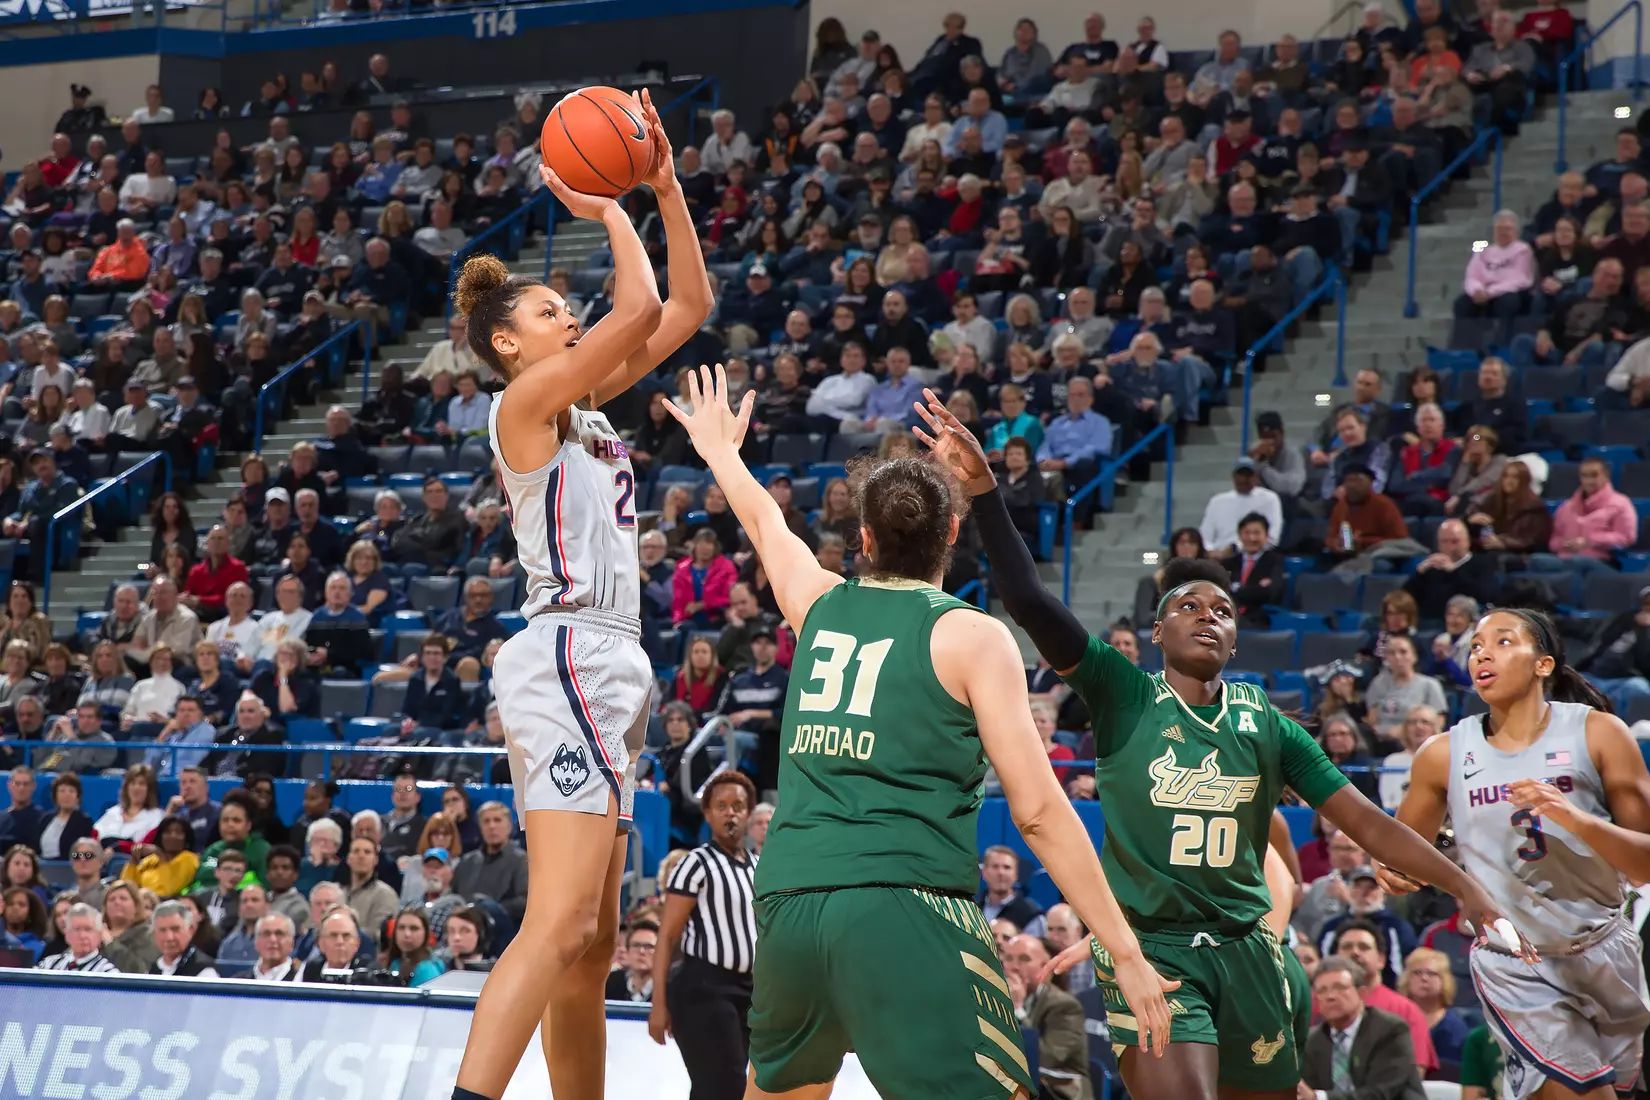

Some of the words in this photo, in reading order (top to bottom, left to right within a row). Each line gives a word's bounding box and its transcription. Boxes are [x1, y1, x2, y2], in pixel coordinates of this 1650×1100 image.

[472, 11, 517, 38] 114
[614, 470, 635, 527] 2
[799, 629, 894, 717] 31
[788, 724, 875, 760] JORDAO
[1148, 745, 1260, 812] USF
[1469, 775, 1574, 807] HUSS
[1169, 814, 1238, 868] 20
[1510, 808, 1548, 862] 3
[0, 1021, 200, 1100] NESS
